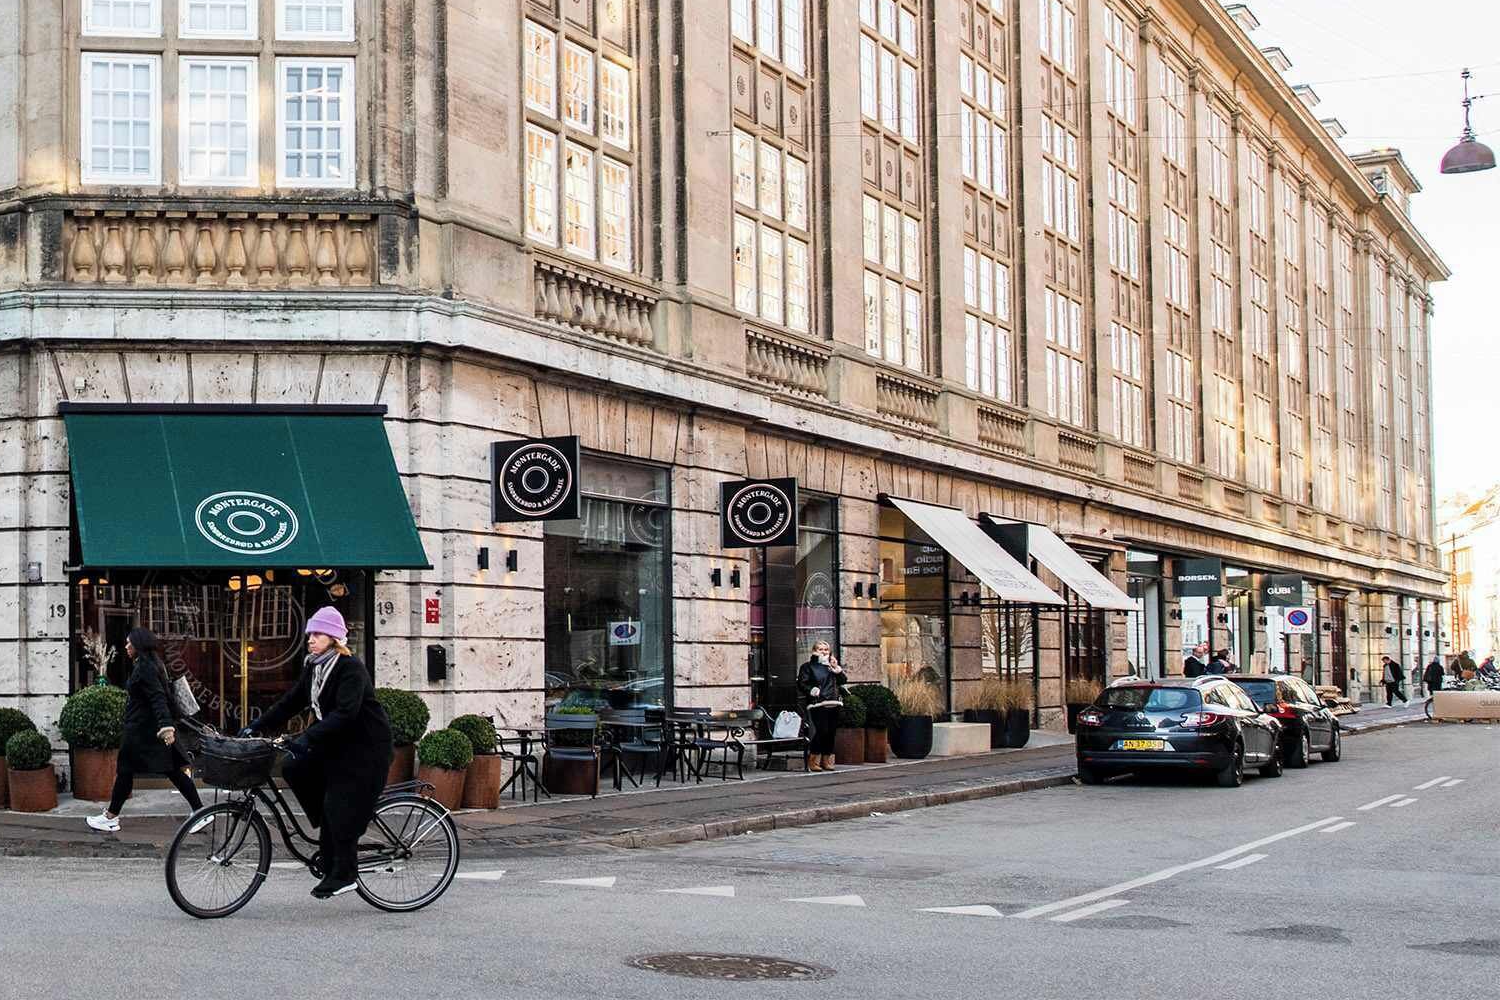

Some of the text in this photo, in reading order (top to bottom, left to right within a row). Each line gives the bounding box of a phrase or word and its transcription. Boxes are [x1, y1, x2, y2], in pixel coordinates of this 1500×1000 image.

[509, 451, 561, 475] MØNTERGADE
[208, 498, 281, 518] MØNTERGADE
[1267, 586, 1291, 595] GUBI
[49, 603, 67, 618] 19
[377, 601, 394, 616] 19
